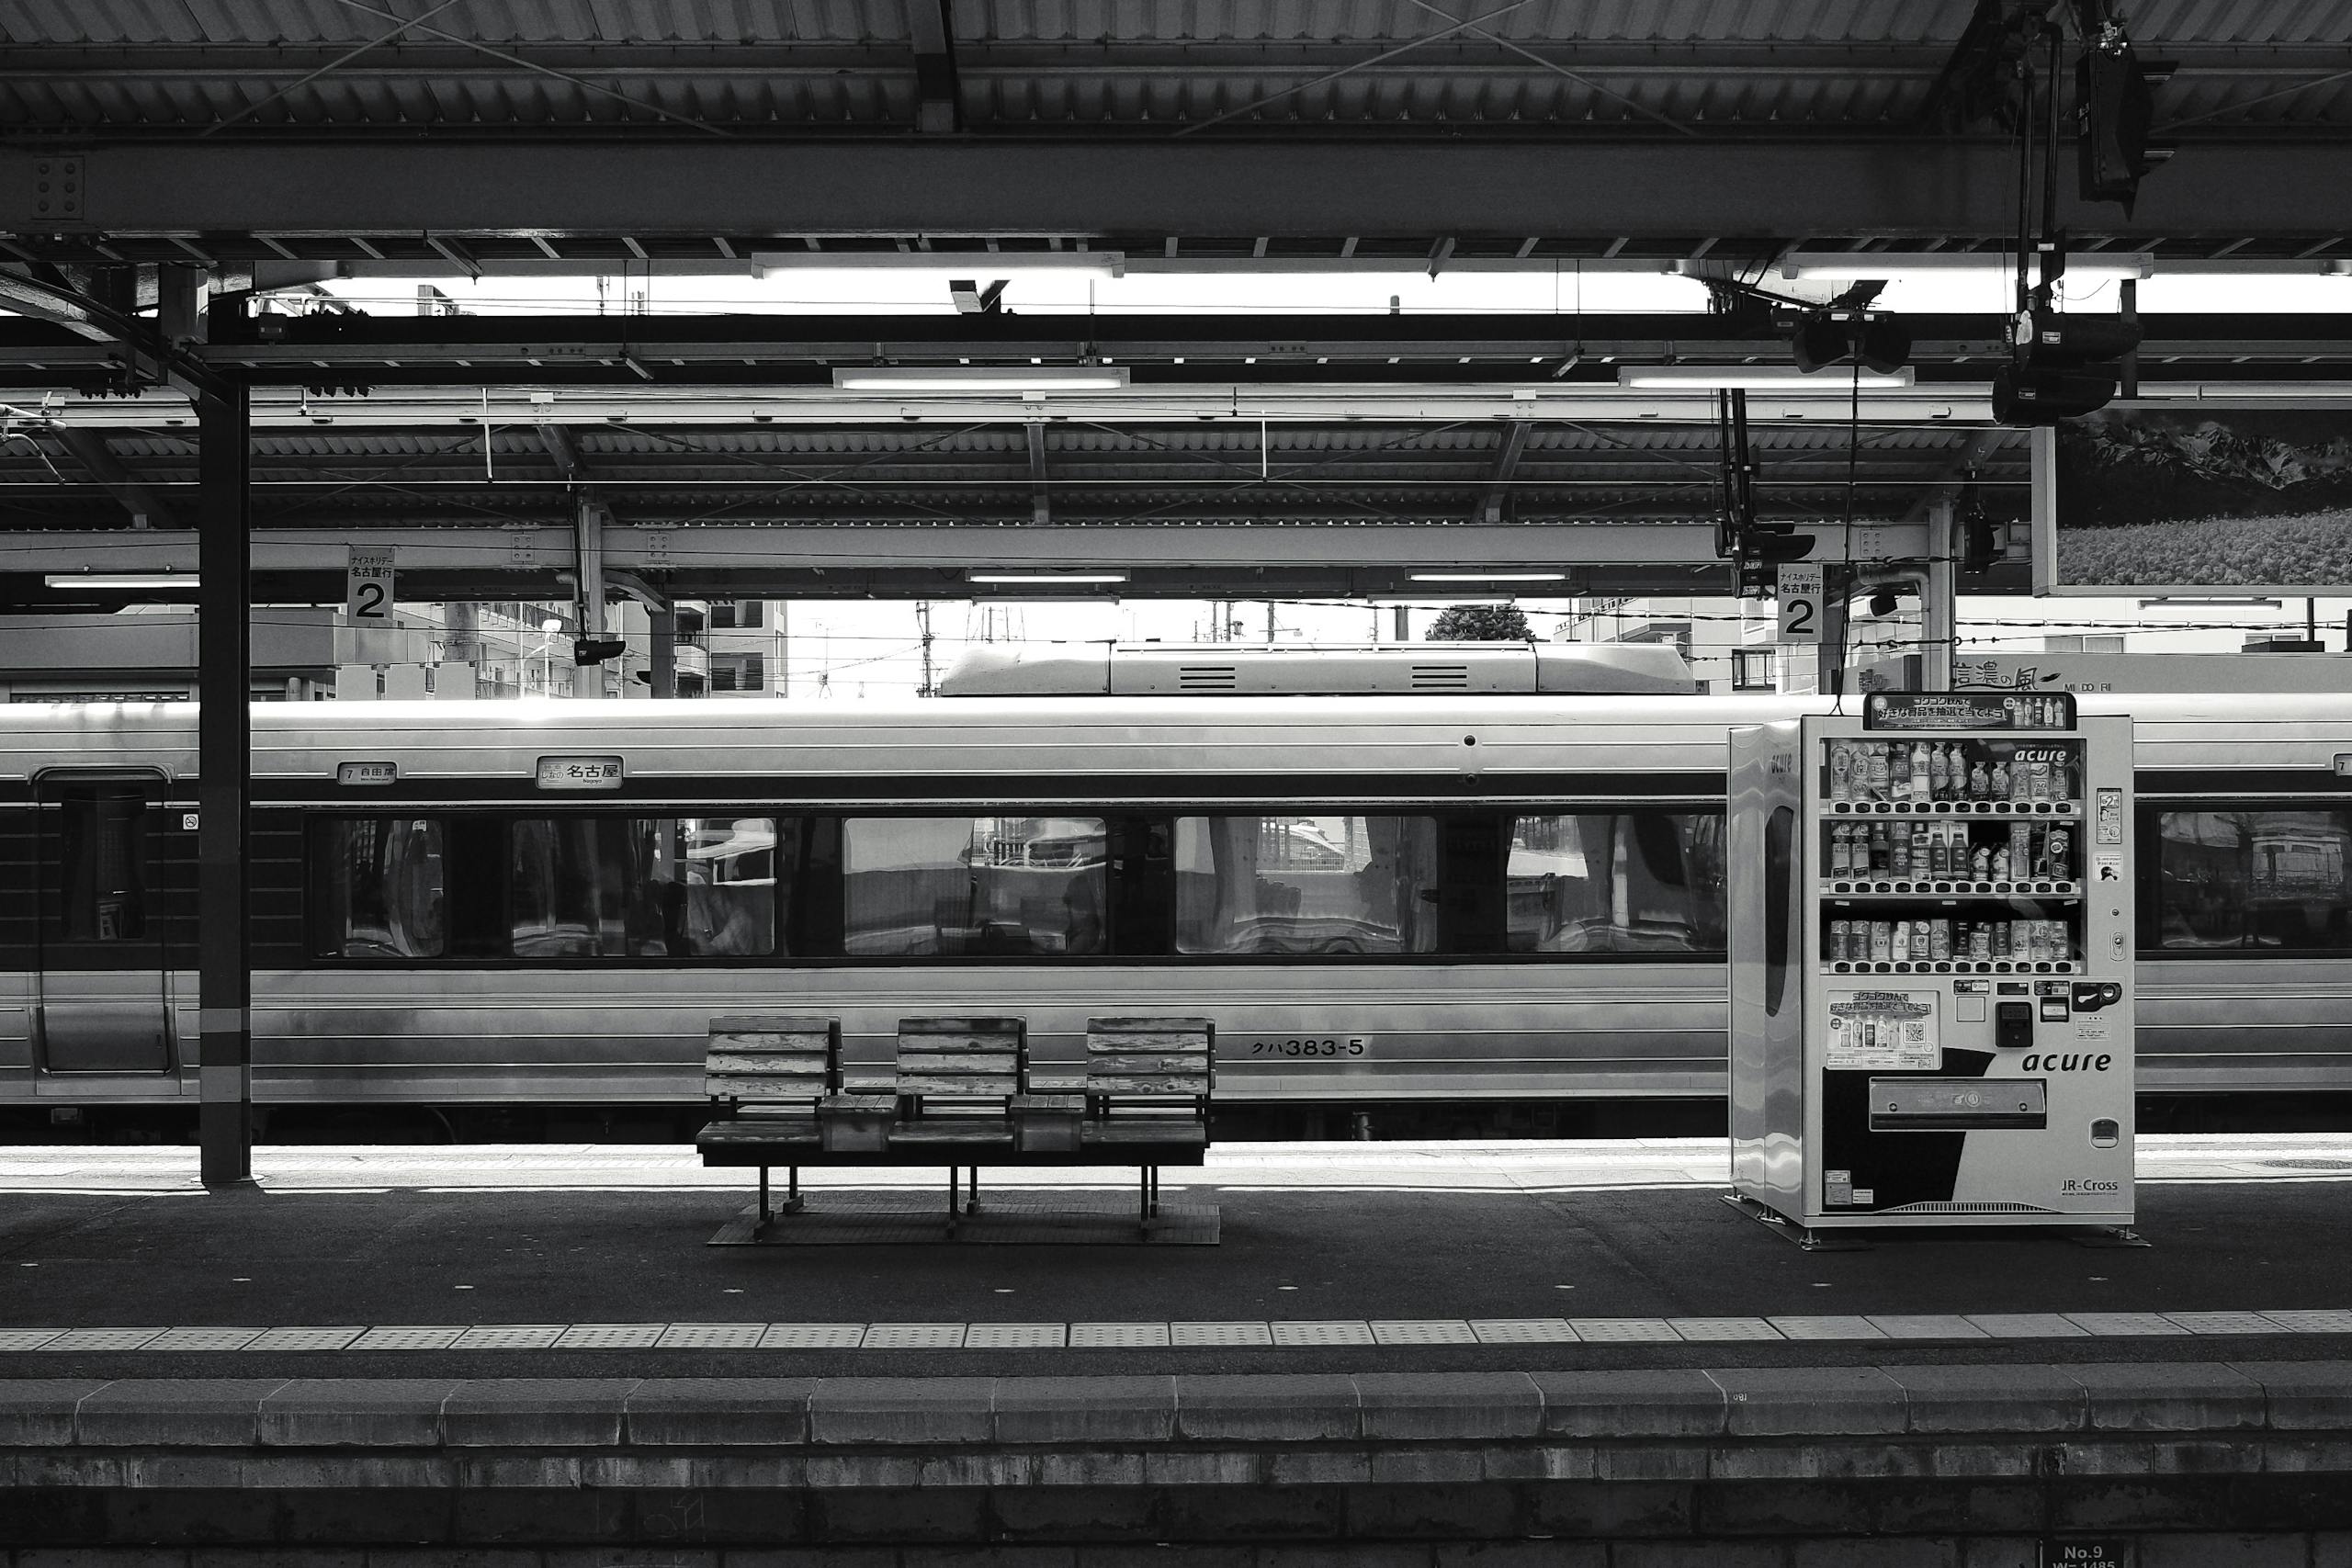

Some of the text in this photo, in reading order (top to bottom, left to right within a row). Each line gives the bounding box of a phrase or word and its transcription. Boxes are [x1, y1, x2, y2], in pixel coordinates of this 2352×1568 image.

[351, 557, 393, 565] ナイスホリデー
[351, 567, 392, 578] 名古屋行
[1781, 583, 1821, 594] 名古屋行
[356, 582, 385, 617] 2
[1785, 599, 1814, 633] 2
[2014, 750, 2066, 761] acure
[567, 764, 619, 778] 名古屋
[2338, 761, 2345, 771] 7
[347, 769, 354, 779] 7
[2022, 1054, 2111, 1071] acure
[2062, 1179, 2118, 1191] JR-Cross
[2064, 1545, 2103, 1559] No.9
